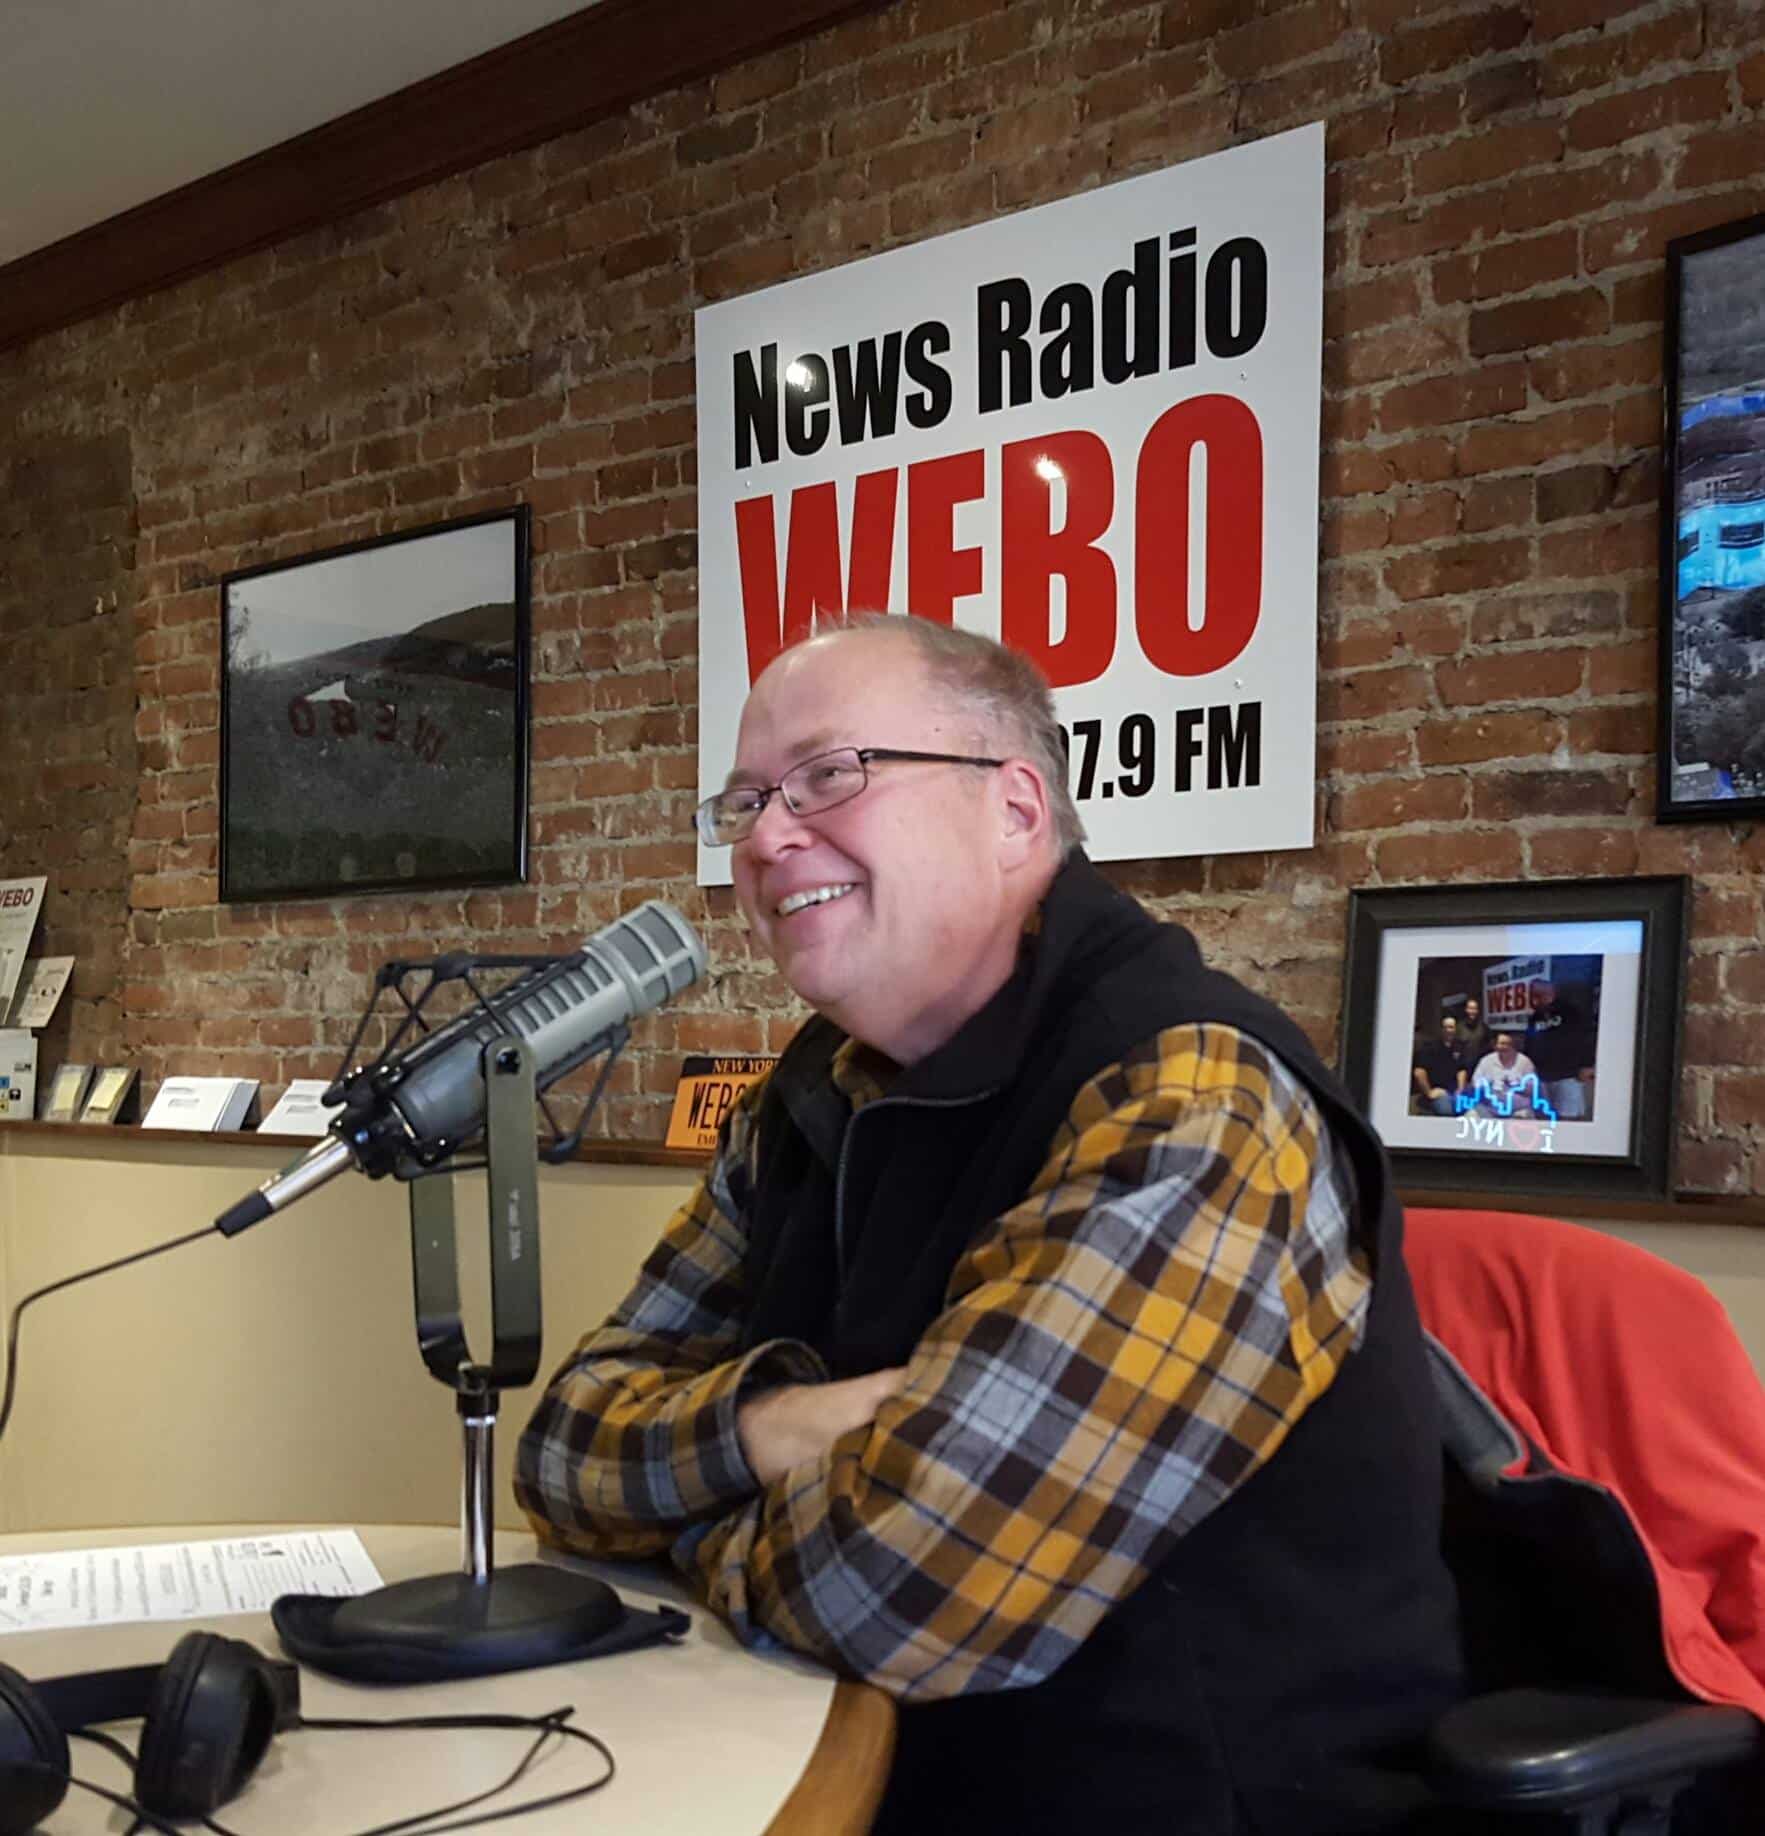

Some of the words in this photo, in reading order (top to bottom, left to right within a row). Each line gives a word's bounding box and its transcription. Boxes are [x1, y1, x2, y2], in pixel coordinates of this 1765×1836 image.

[733, 321, 952, 470] News
[977, 226, 1268, 414] Radio
[1057, 712, 1156, 801] 7.9
[1174, 701, 1262, 793] FM
[713, 1059, 745, 1073] NEW
[688, 1081, 748, 1129] WEB
